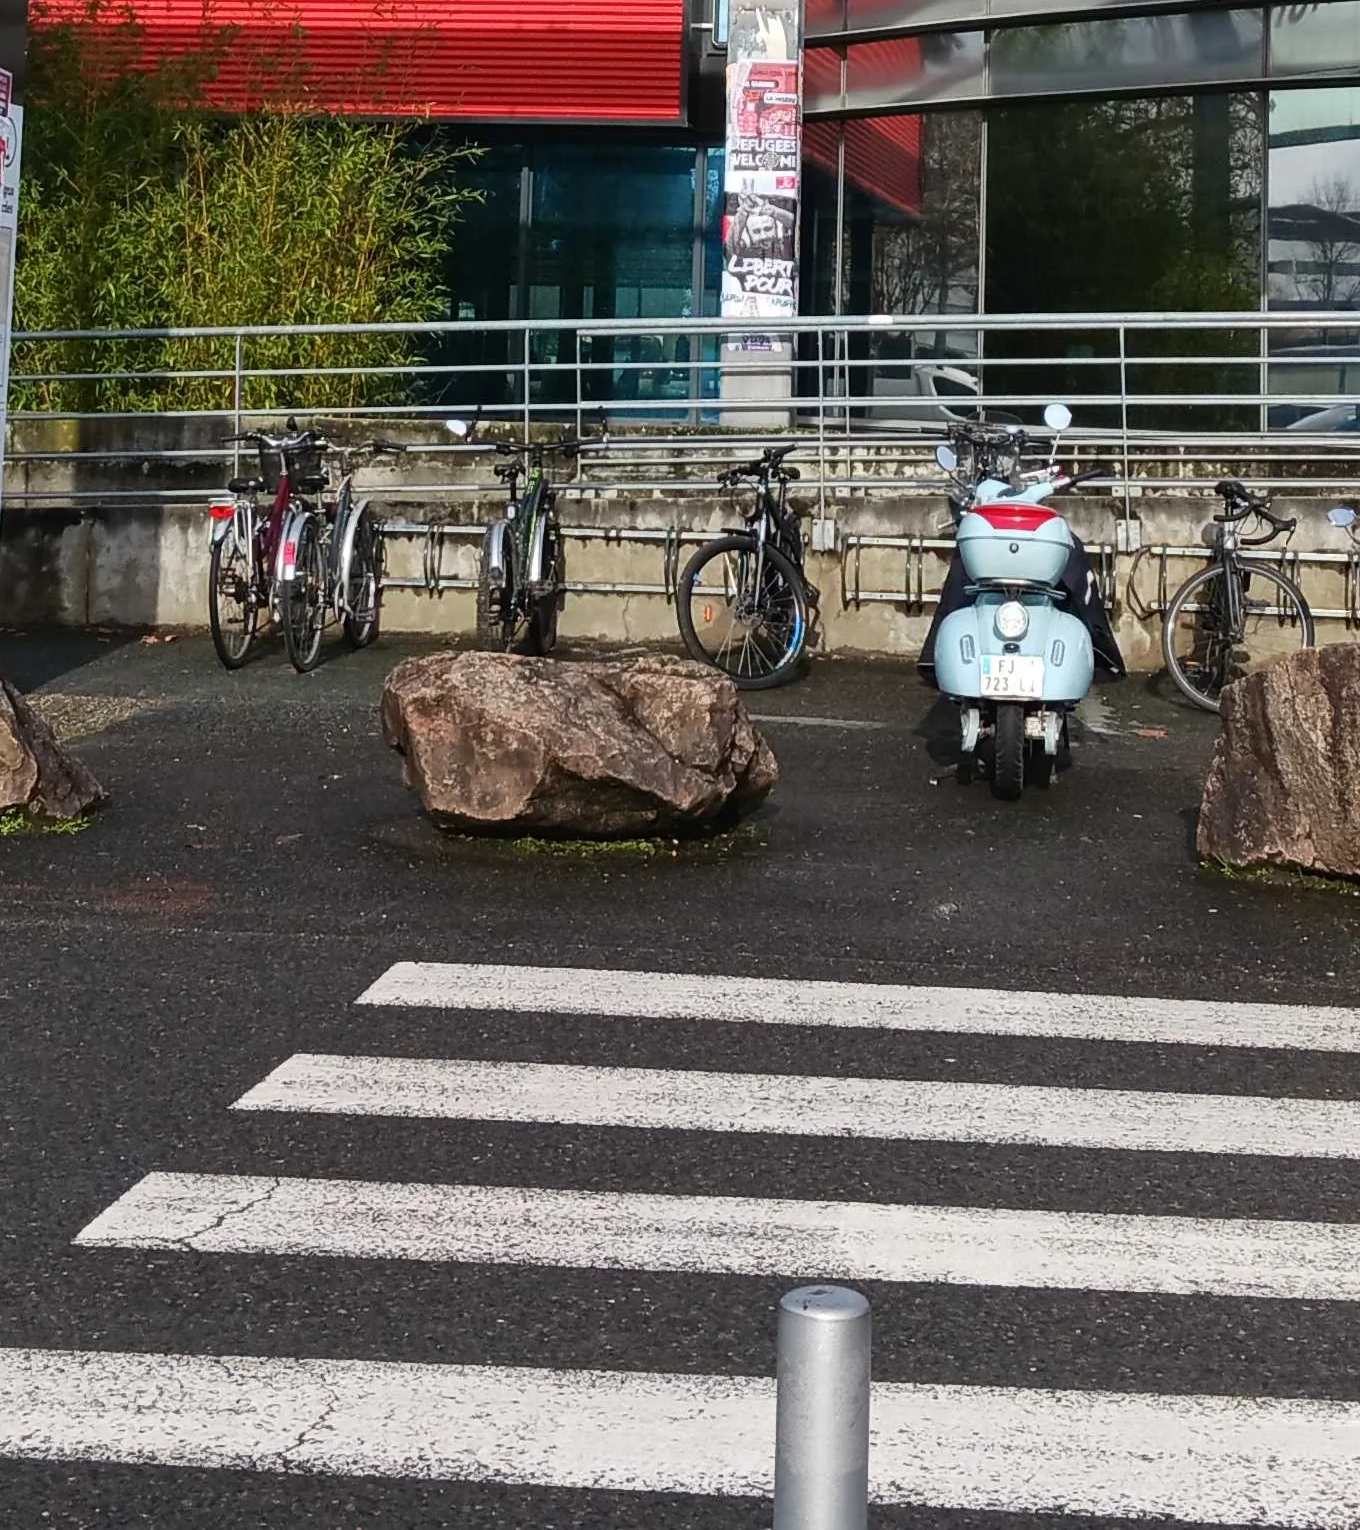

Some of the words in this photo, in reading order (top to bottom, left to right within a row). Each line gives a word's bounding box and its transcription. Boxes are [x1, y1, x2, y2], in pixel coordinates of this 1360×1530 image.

[743, 274, 794, 297] POUR
[998, 659, 1015, 674] FJ
[985, 676, 1009, 691] 723
